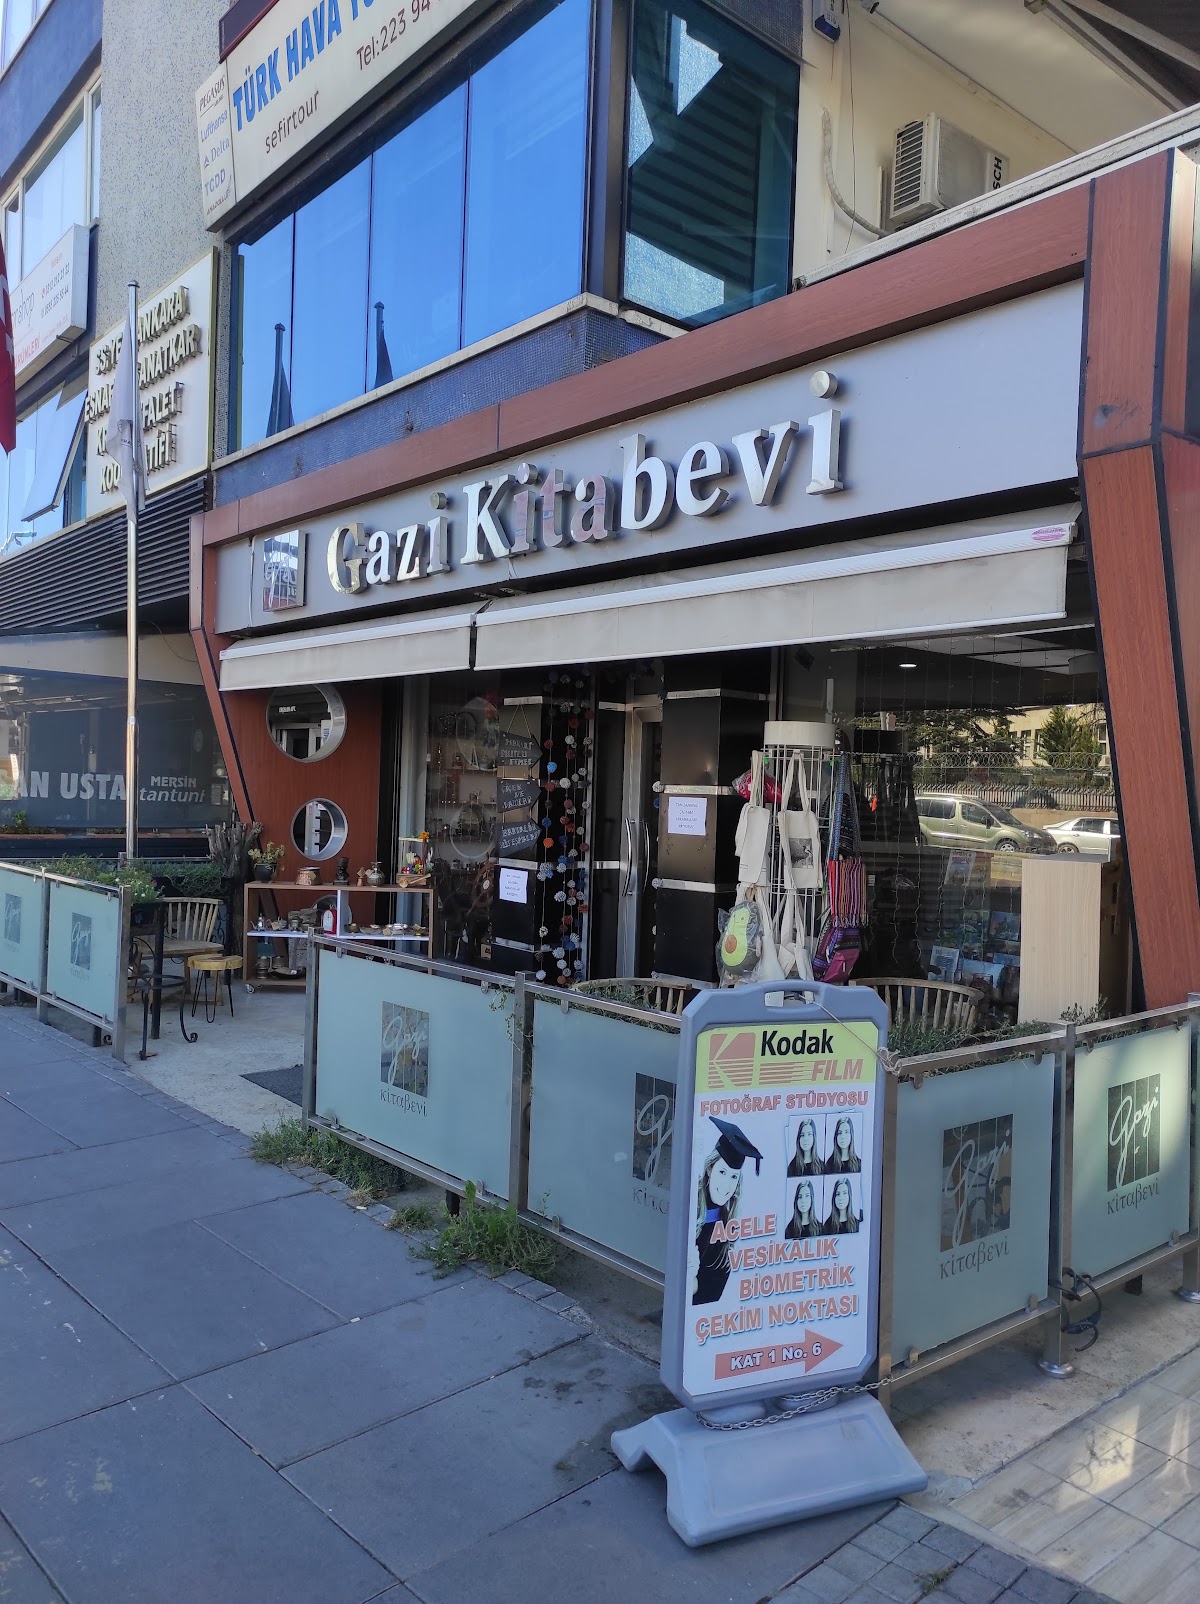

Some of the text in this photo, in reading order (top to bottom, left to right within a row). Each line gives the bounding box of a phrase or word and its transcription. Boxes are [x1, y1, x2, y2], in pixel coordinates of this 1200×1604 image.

[233, 0, 342, 132] TÜRK HAVA
[200, 75, 226, 111] PEGASUS
[201, 109, 228, 143] Lufthansa
[265, 90, 320, 154] sefirtour
[211, 138, 230, 162] Delta
[204, 168, 226, 196] TCDD
[138, 285, 185, 343] ANKARA
[141, 382, 177, 431] FALET
[327, 371, 845, 595] Gazi Kitabevi
[60, 773, 126, 800] USTA
[139, 784, 206, 803] tantuni
[150, 776, 197, 789] MERSİN
[760, 1029, 834, 1057] Kodak
[811, 1058, 864, 1082] FILM
[700, 1090, 869, 1117] FOTOĞRAF STÜDYOSU
[709, 1213, 776, 1244] ACELE
[728, 1237, 840, 1273] VESİKALIK
[739, 1262, 854, 1300] BİOMETRİK
[695, 1294, 858, 1345] ÇEKİM NOKTASI
[730, 1341, 822, 1371] KAT 1 No. 6
